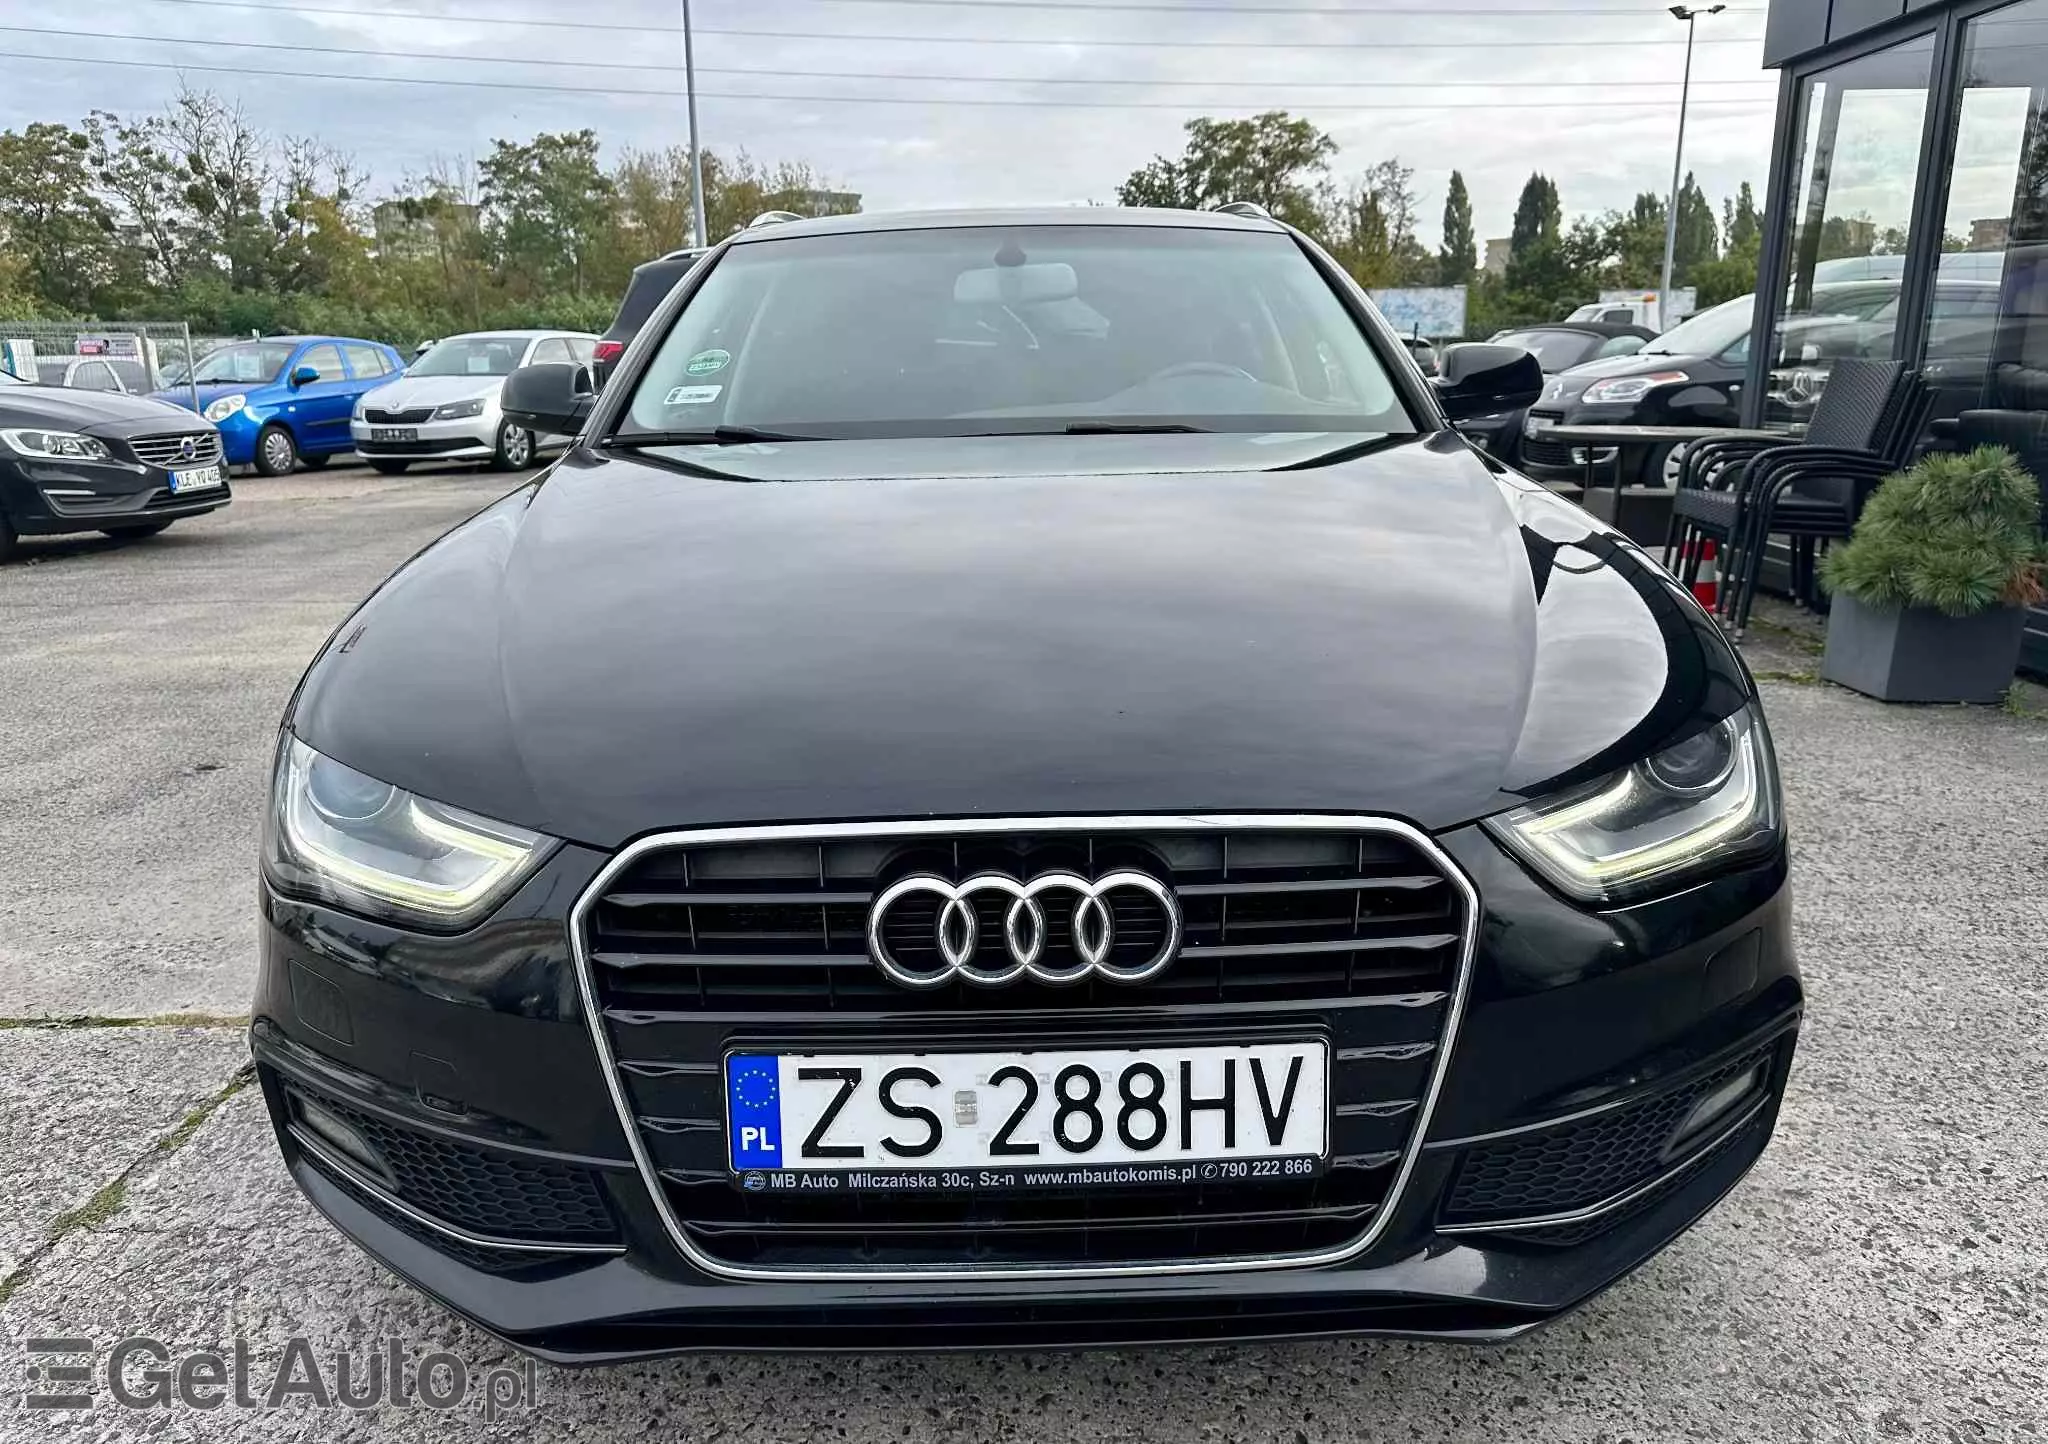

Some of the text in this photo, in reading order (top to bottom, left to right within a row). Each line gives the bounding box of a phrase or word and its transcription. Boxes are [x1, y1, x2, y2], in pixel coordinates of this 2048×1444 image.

[798, 1055, 1304, 1158] ZS 288HV
[741, 1127, 775, 1151] PL
[771, 1158, 1312, 1191] MB Auto Milczańska 30c, Sz-n www.mbautokomis.pl 790 222 866
